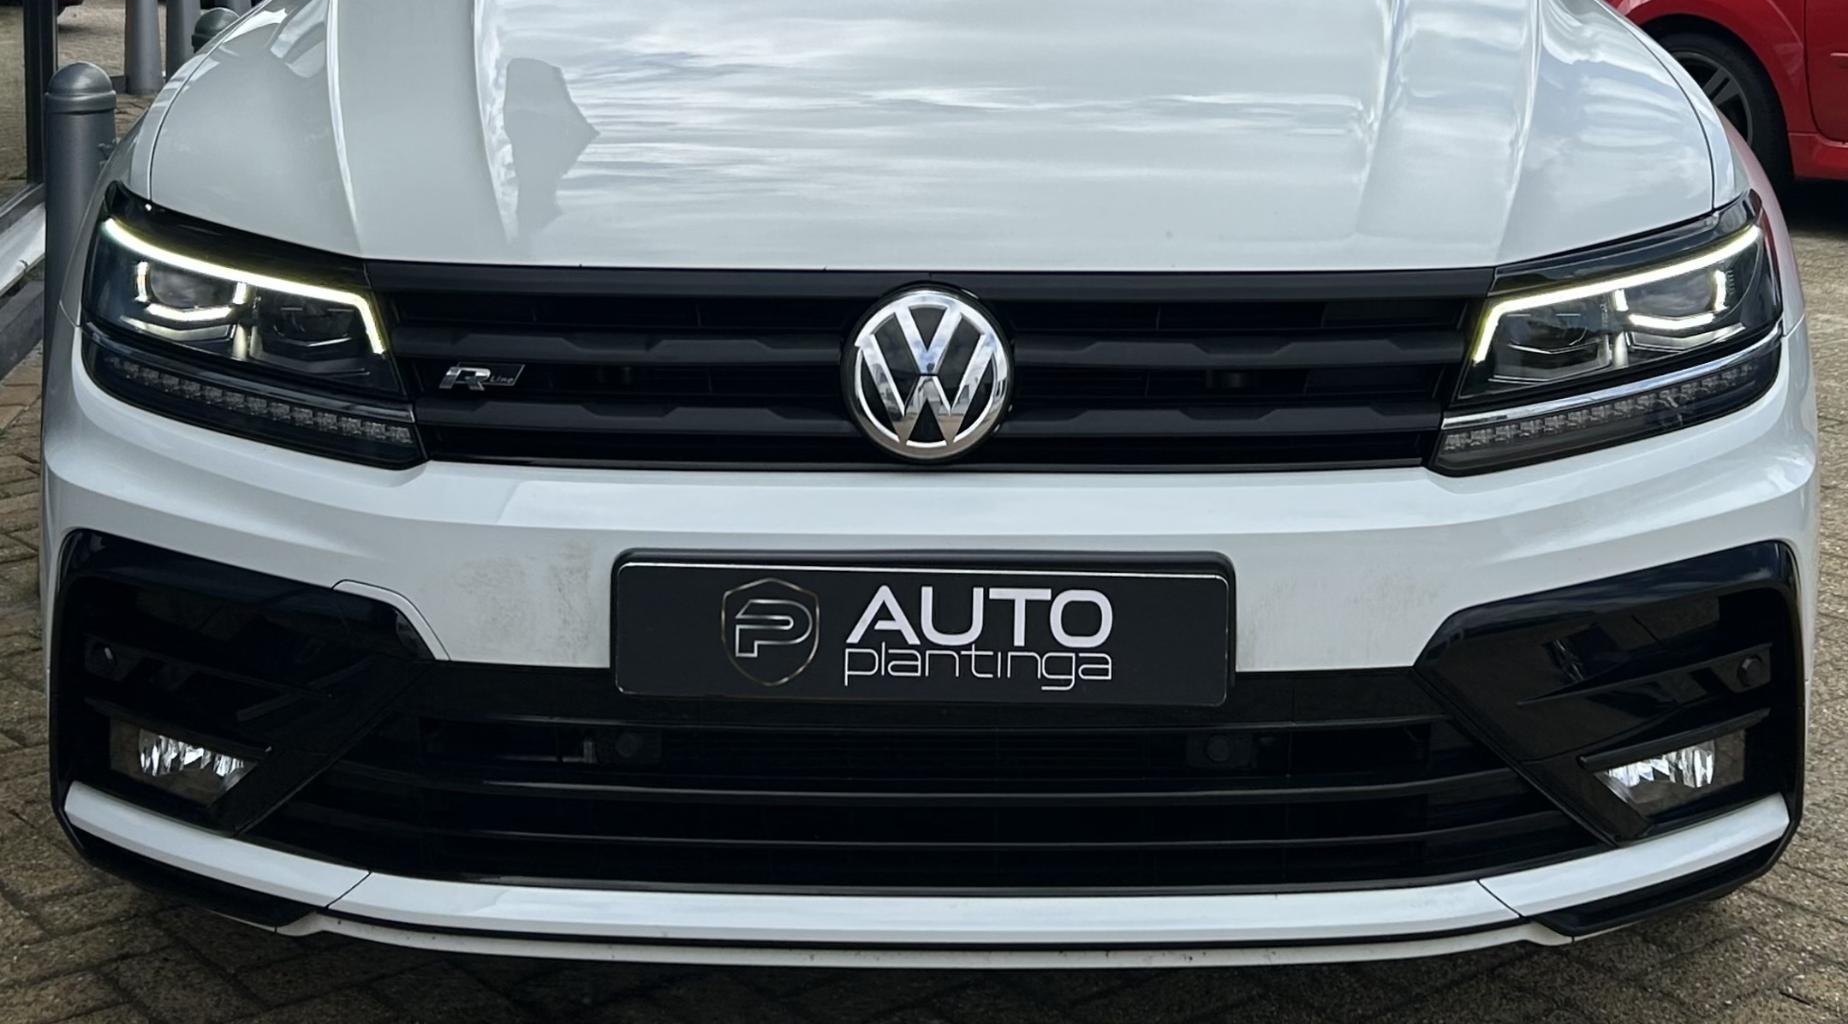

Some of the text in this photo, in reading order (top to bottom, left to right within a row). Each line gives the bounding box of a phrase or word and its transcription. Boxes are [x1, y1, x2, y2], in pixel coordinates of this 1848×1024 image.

[439, 366, 491, 391] R
[845, 584, 1114, 649] AUTO
[844, 641, 1113, 691] plantinga
